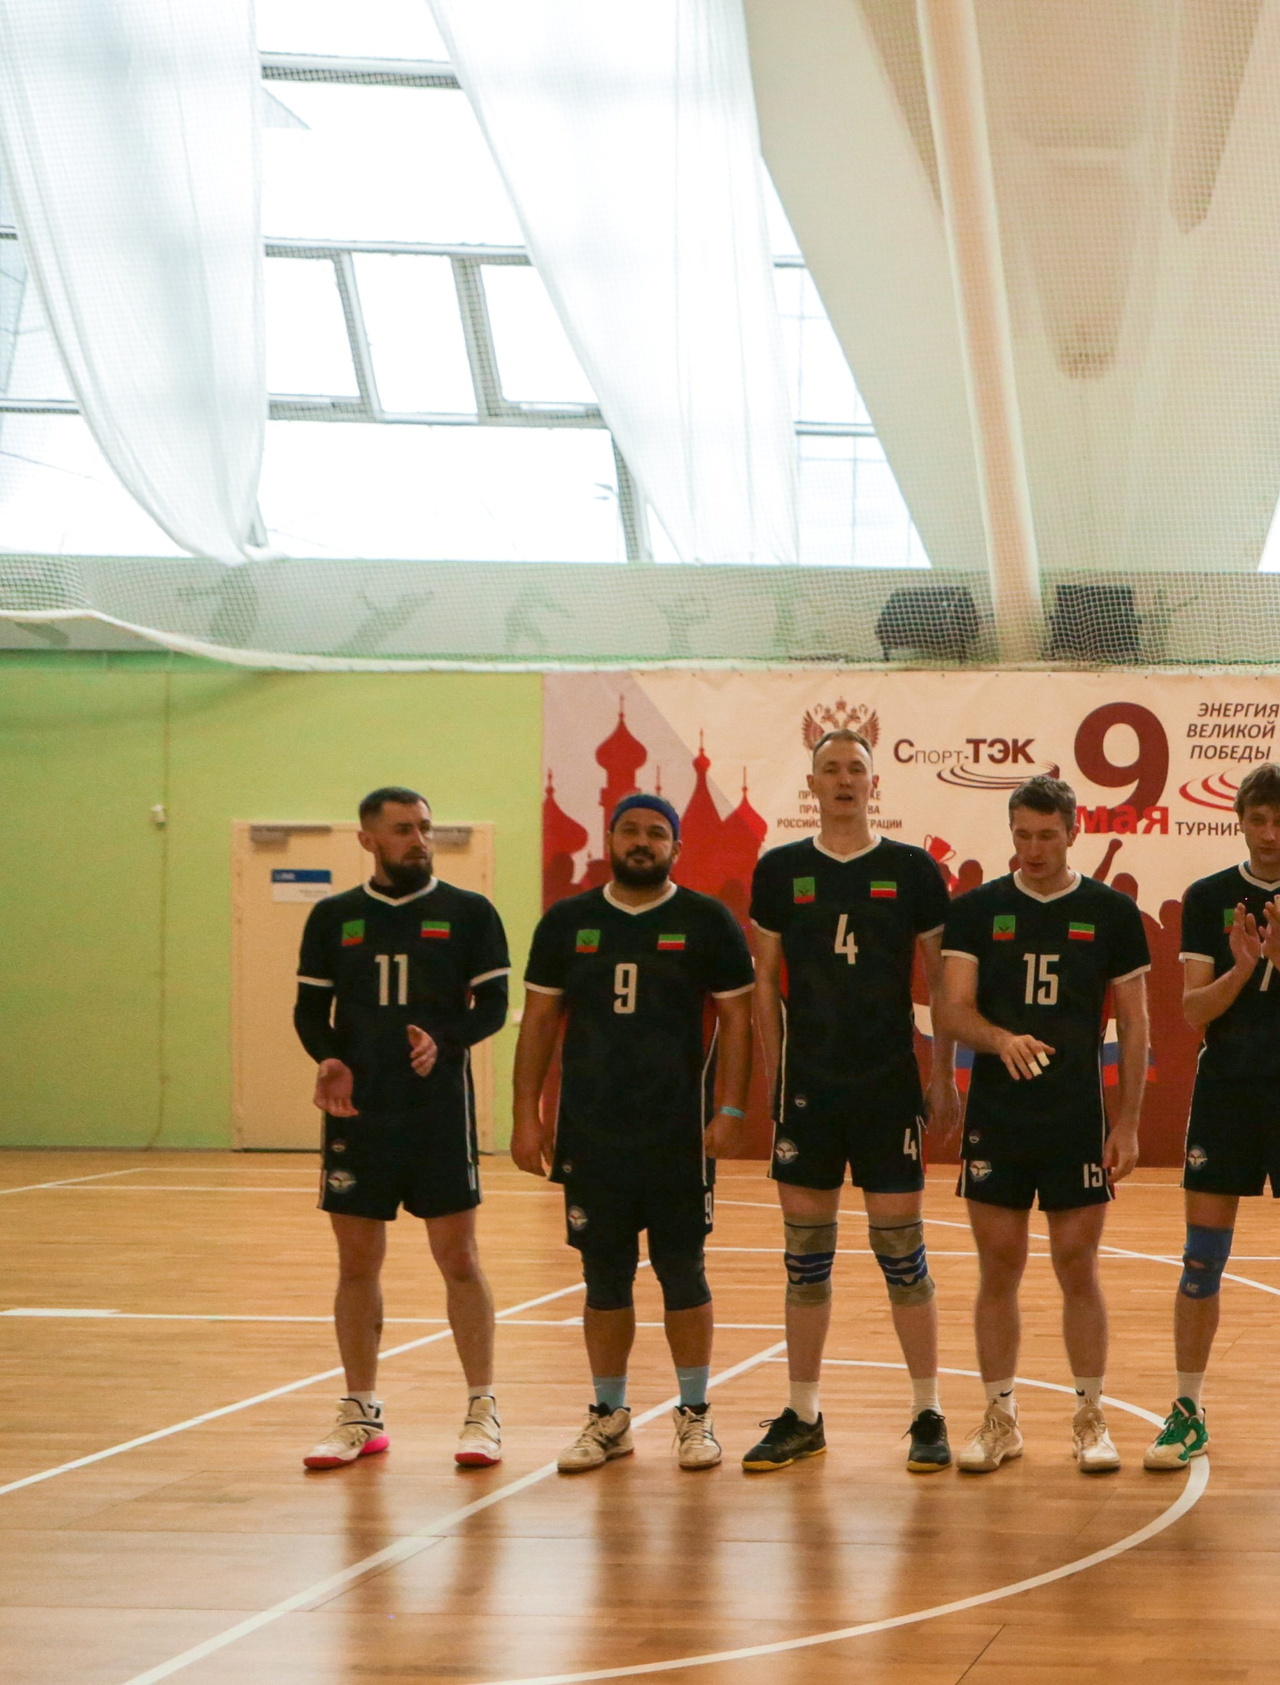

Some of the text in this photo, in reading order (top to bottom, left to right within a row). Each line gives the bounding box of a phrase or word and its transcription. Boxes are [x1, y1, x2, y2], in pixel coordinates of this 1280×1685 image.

[1197, 702, 1280, 718] ЭНЕРГИЯ
[1186, 720, 1276, 739] ВЕЛИКОЙ
[1074, 701, 1169, 833] 9
[1190, 744, 1271, 763] ПОБЕДЫ
[777, 816, 903, 829] РОССИЙС РАЦИИ
[1076, 804, 1169, 835] мая
[834, 914, 858, 964] 4
[375, 954, 408, 1006] 11
[614, 963, 638, 1014] 9
[1023, 952, 1060, 1006] 15
[903, 1128, 917, 1161] 4
[1083, 1163, 1103, 1188] 15
